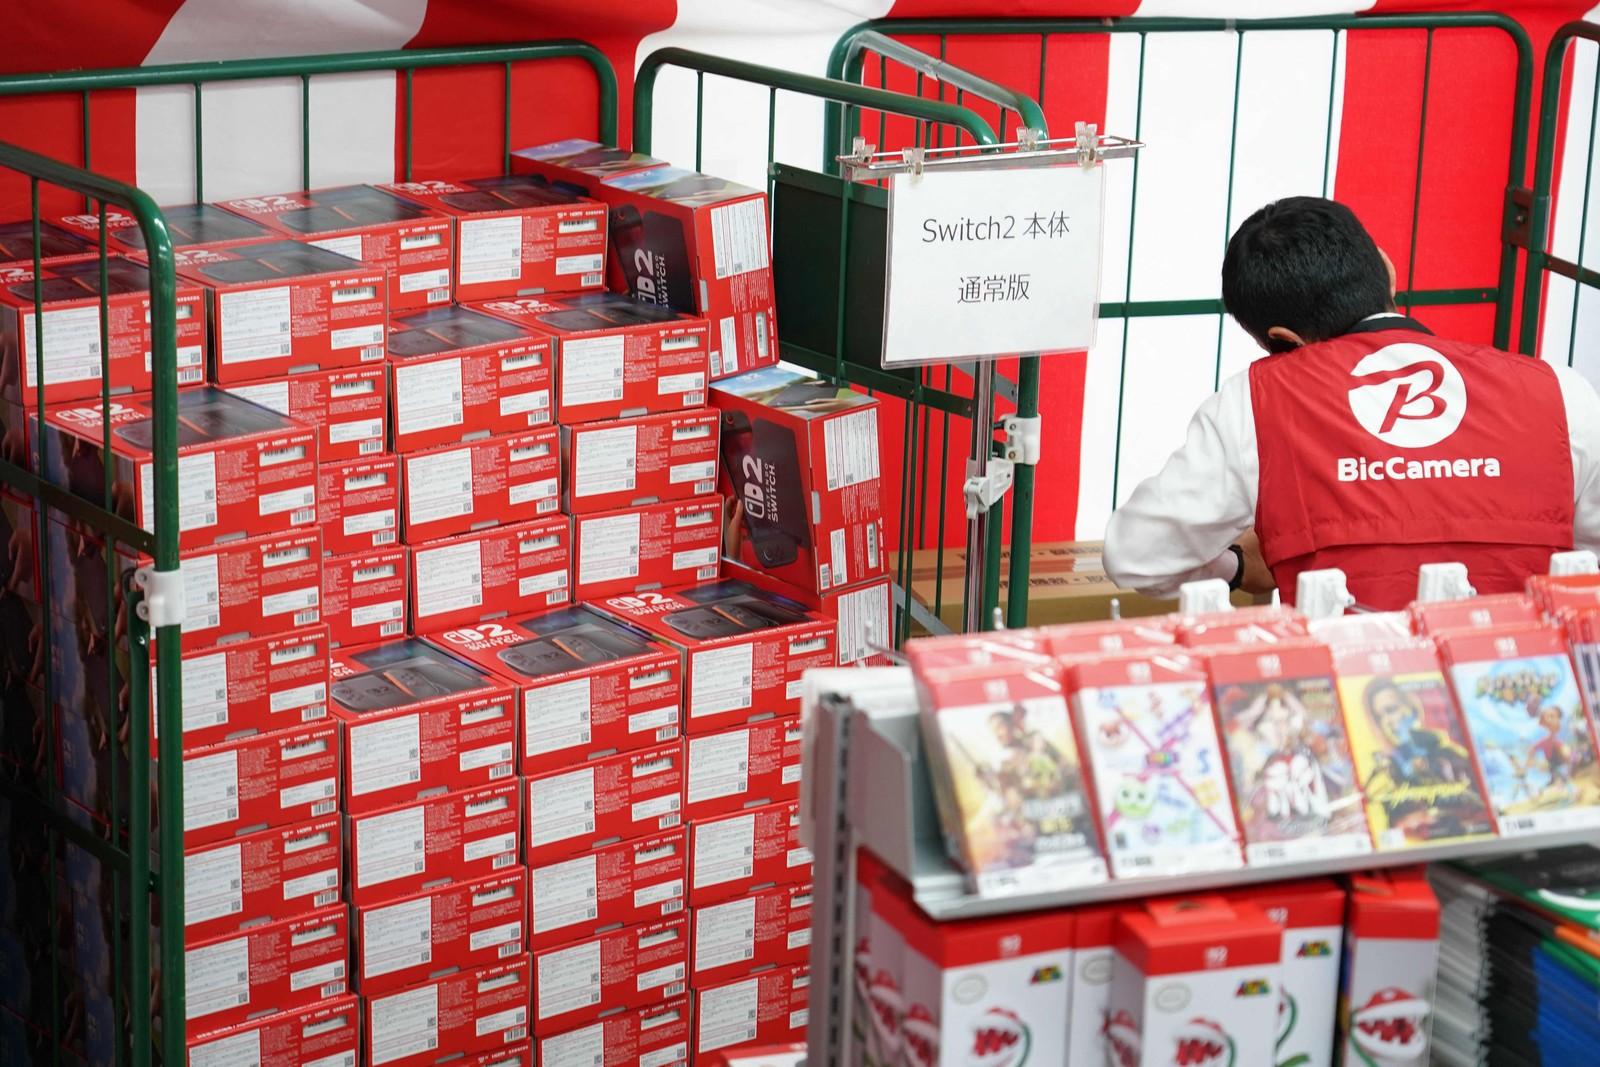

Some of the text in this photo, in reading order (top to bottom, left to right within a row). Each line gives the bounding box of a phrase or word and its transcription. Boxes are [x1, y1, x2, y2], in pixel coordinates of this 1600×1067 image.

[922, 211, 1070, 243] Switch2 本体
[634, 248, 654, 276] 2
[957, 273, 1031, 304] 通常版
[742, 454, 763, 484] 2
[1337, 456, 1502, 482] BicCamera
[768, 464, 779, 522] SWITCH
[636, 592, 674, 604] 2
[476, 623, 514, 637] 2
